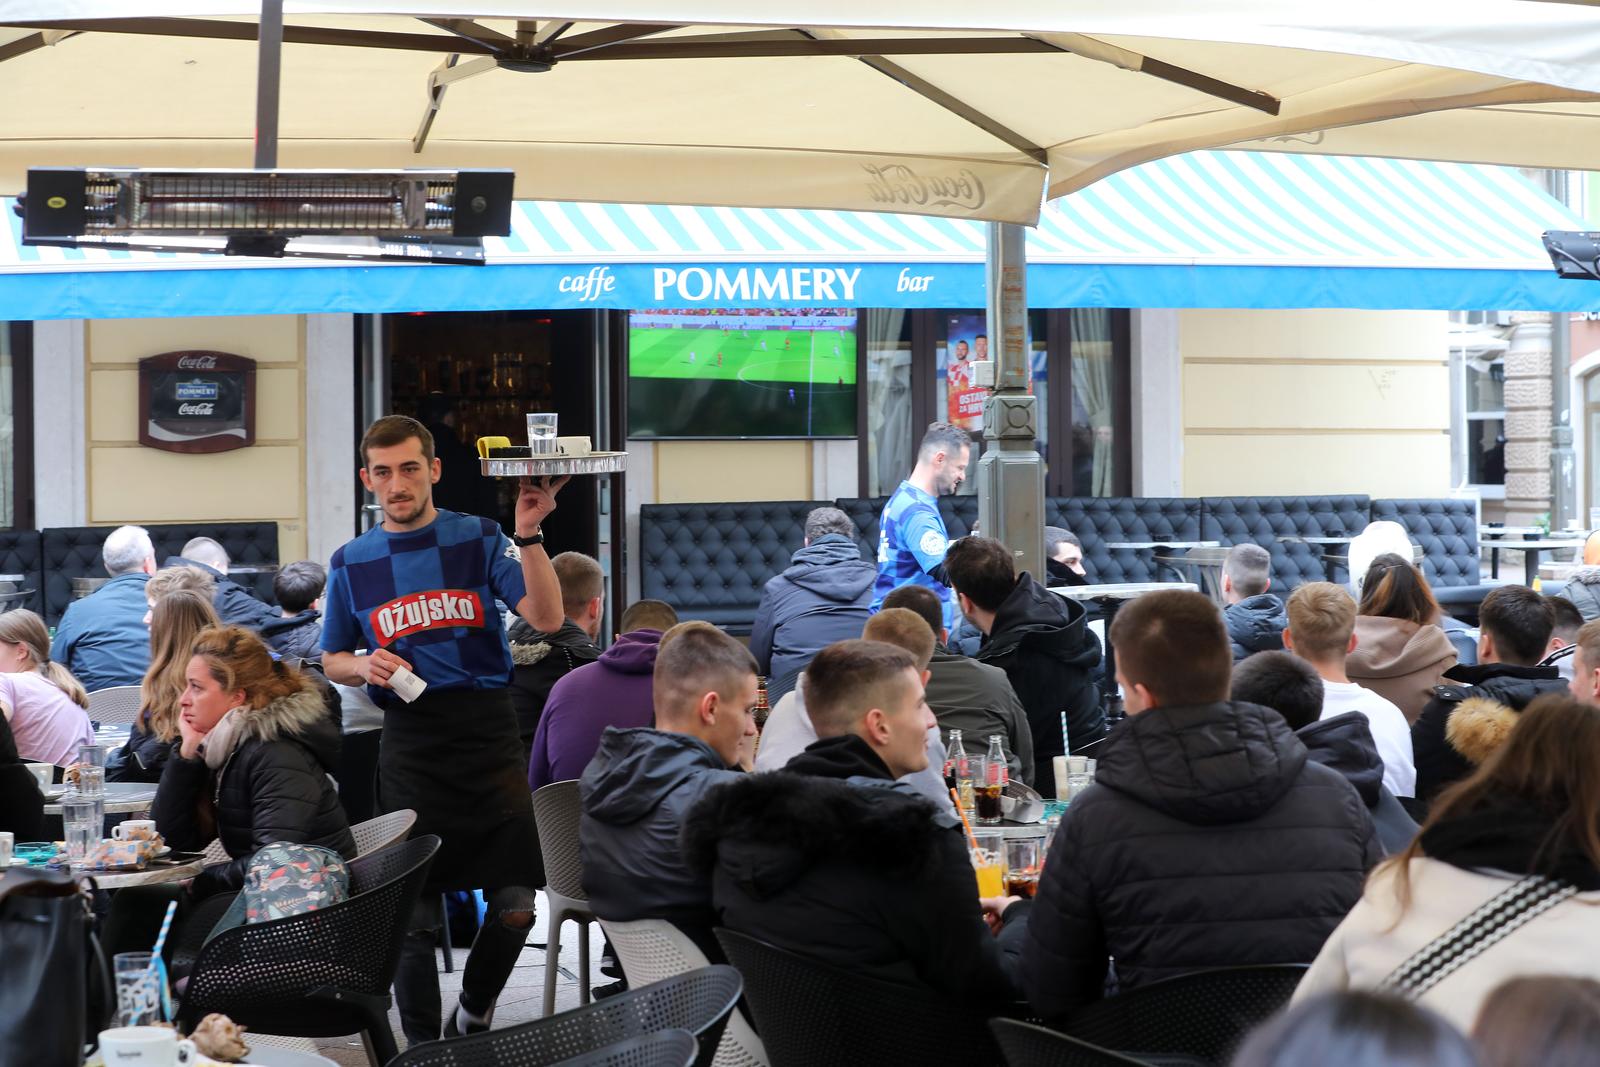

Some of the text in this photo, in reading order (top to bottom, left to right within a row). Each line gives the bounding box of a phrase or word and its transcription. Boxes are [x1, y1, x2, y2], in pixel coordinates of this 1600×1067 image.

[559, 266, 935, 302] caffe POMMERY bar
[377, 592, 475, 638] Ožujsko
